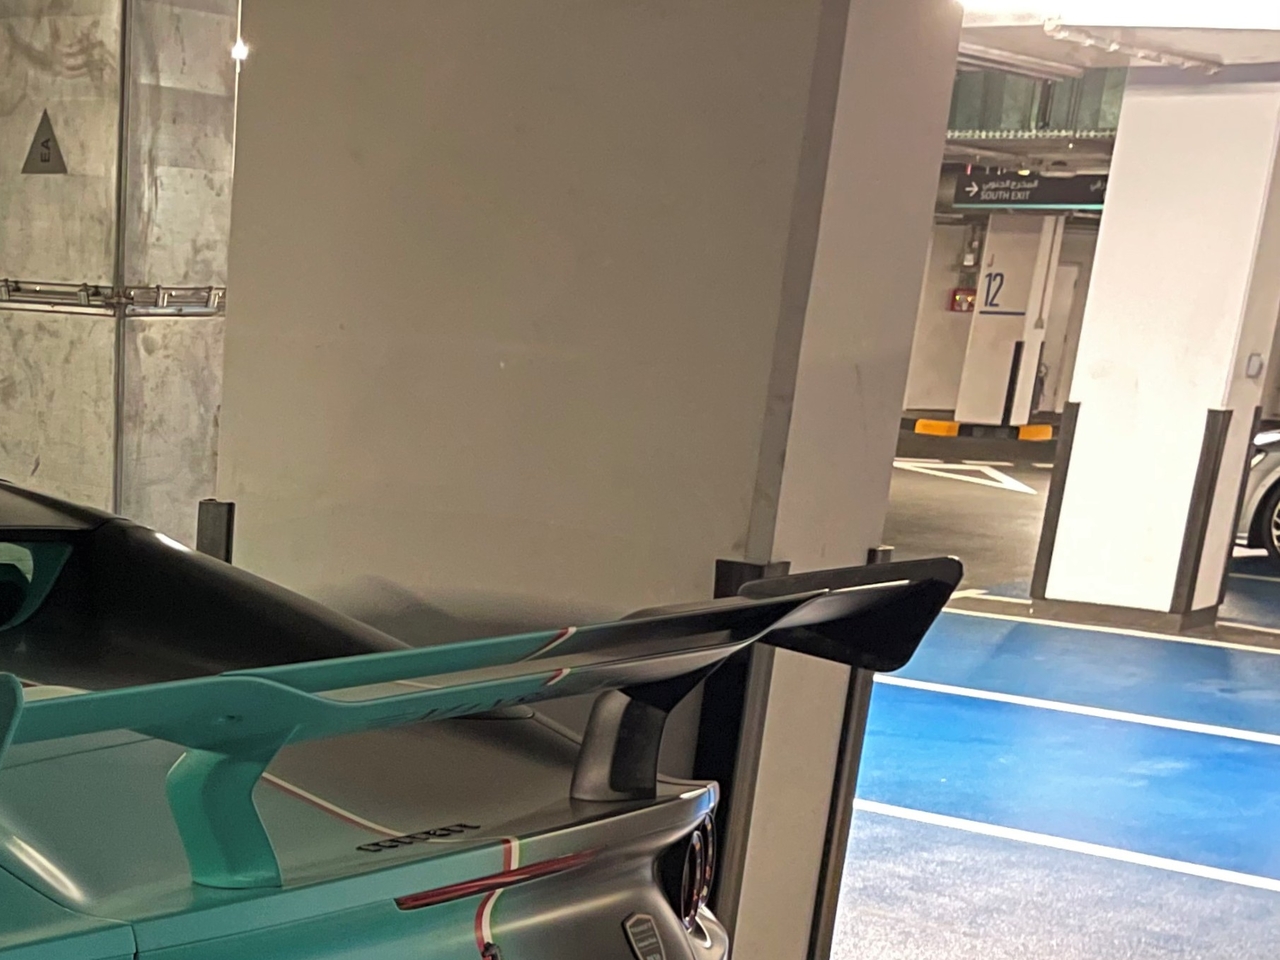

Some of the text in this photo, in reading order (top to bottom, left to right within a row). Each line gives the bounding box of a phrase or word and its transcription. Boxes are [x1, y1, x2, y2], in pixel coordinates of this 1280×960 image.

[40, 138, 51, 162] EA
[980, 190, 1031, 200] SOUTH EXIT
[984, 271, 1005, 307] 12
